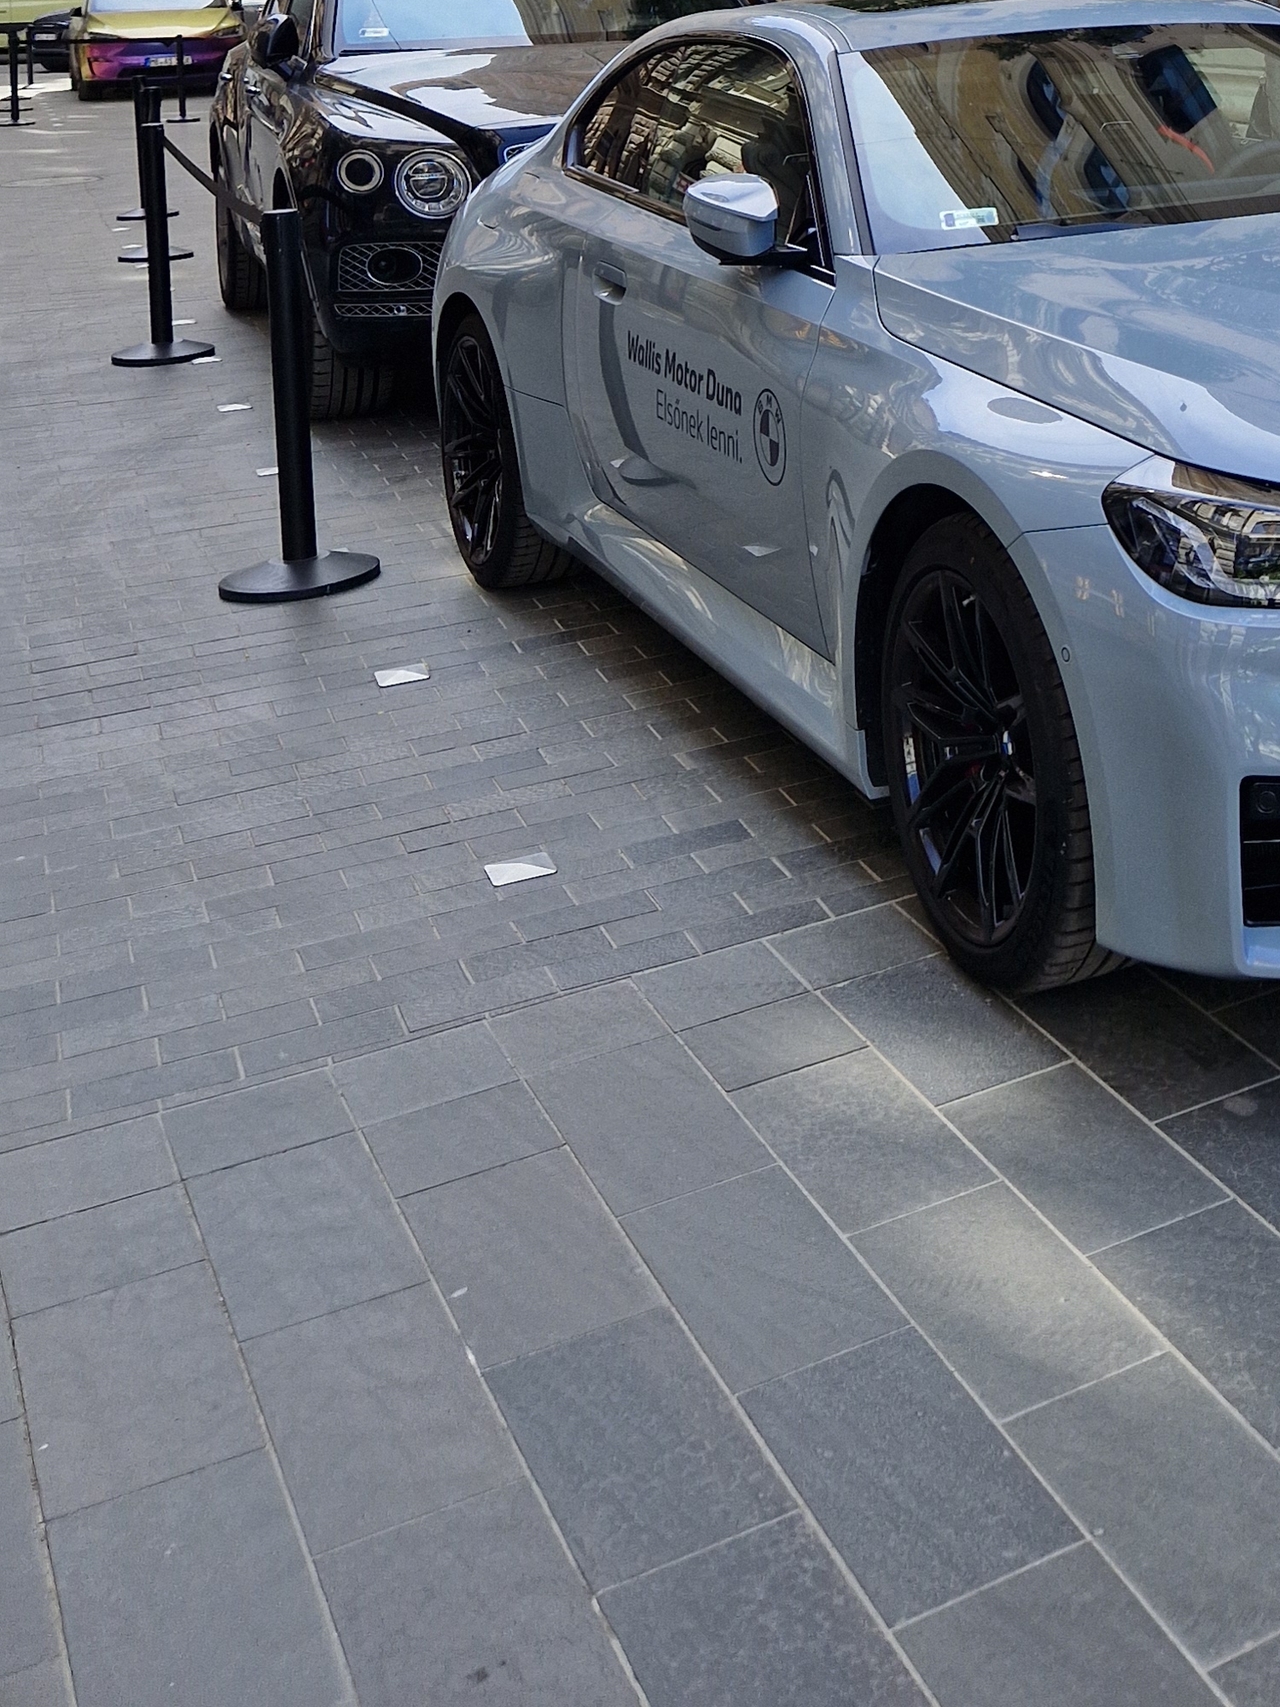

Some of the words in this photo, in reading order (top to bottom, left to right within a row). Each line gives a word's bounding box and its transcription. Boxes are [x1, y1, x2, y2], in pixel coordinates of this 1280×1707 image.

[627, 330, 662, 374] Wallis
[664, 348, 704, 395] Motor
[706, 368, 742, 416] Duna
[757, 394, 782, 424] BMW
[656, 388, 704, 442] Elsőnek
[706, 415, 743, 464] lenni.
